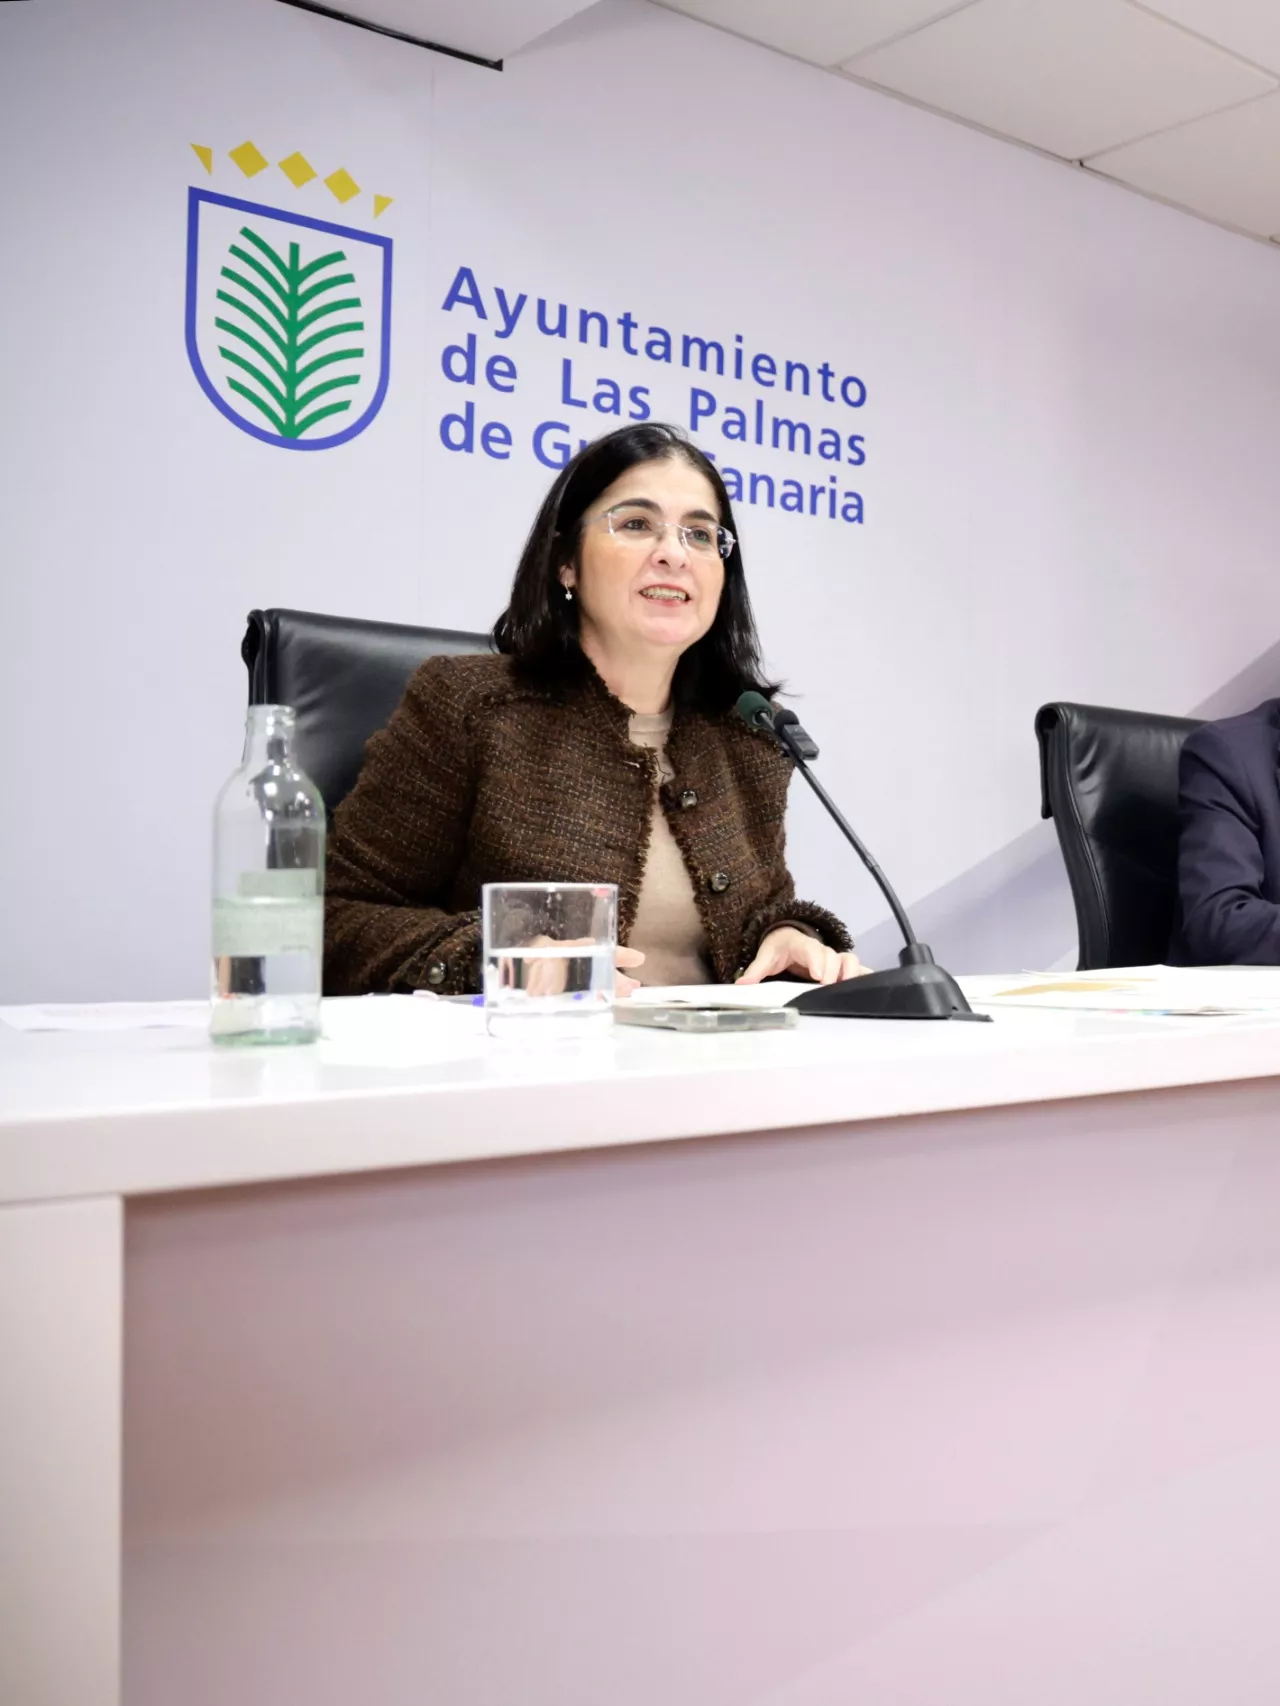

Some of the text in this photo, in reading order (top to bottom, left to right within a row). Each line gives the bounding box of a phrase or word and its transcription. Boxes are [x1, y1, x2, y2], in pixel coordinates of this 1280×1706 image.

[441, 333, 867, 466] de Las Palmas
[442, 266, 868, 409] Ayuntamiento
[439, 401, 513, 460] de
[702, 450, 865, 525] anaria
